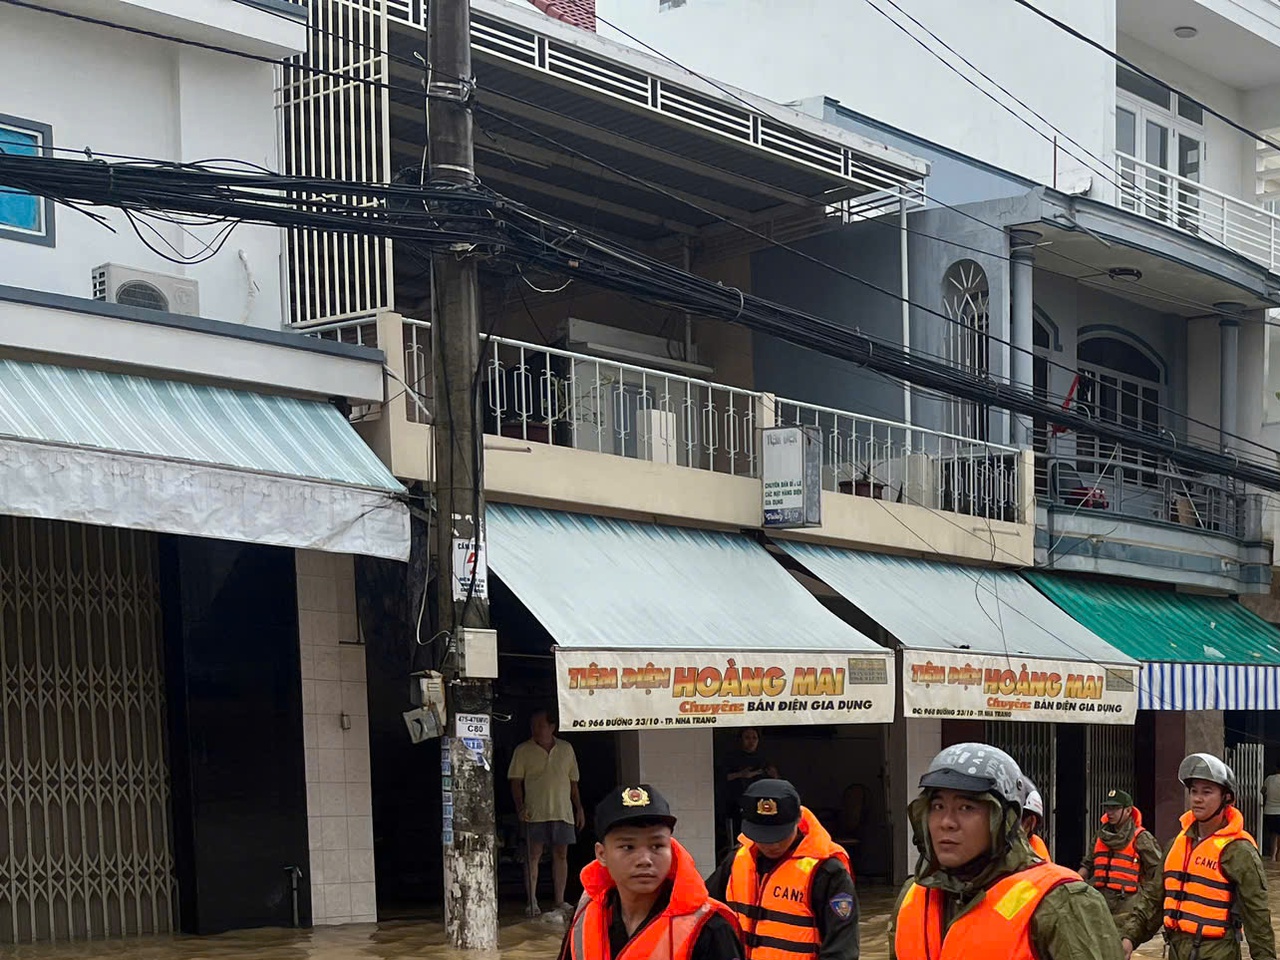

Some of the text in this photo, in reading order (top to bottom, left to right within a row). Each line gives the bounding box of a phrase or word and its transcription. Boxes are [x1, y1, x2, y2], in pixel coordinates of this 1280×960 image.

[568, 661, 618, 696] TIỆM
[621, 661, 671, 696] ĐIỆN
[672, 657, 787, 698] HOÀNG
[791, 666, 846, 696] MAI
[911, 660, 945, 689] TIỆM
[948, 662, 983, 691] ĐIỆN
[1064, 673, 1104, 700] MAI
[747, 698, 774, 712] BÁN
[778, 698, 808, 714] ĐIỆN
[811, 700, 835, 711] GIA
[837, 700, 873, 713] DỤNG
[1034, 699, 1054, 710] BÁN
[1056, 700, 1077, 713] ĐIỆN
[1079, 703, 1095, 712] GIA
[1097, 704, 1123, 715] DỤNG
[467, 725, 484, 733] C80
[588, 719, 605, 727] 966
[606, 717, 633, 727] ĐƯỜNG
[634, 718, 659, 726] 23/10
[692, 716, 717, 724] TRANG
